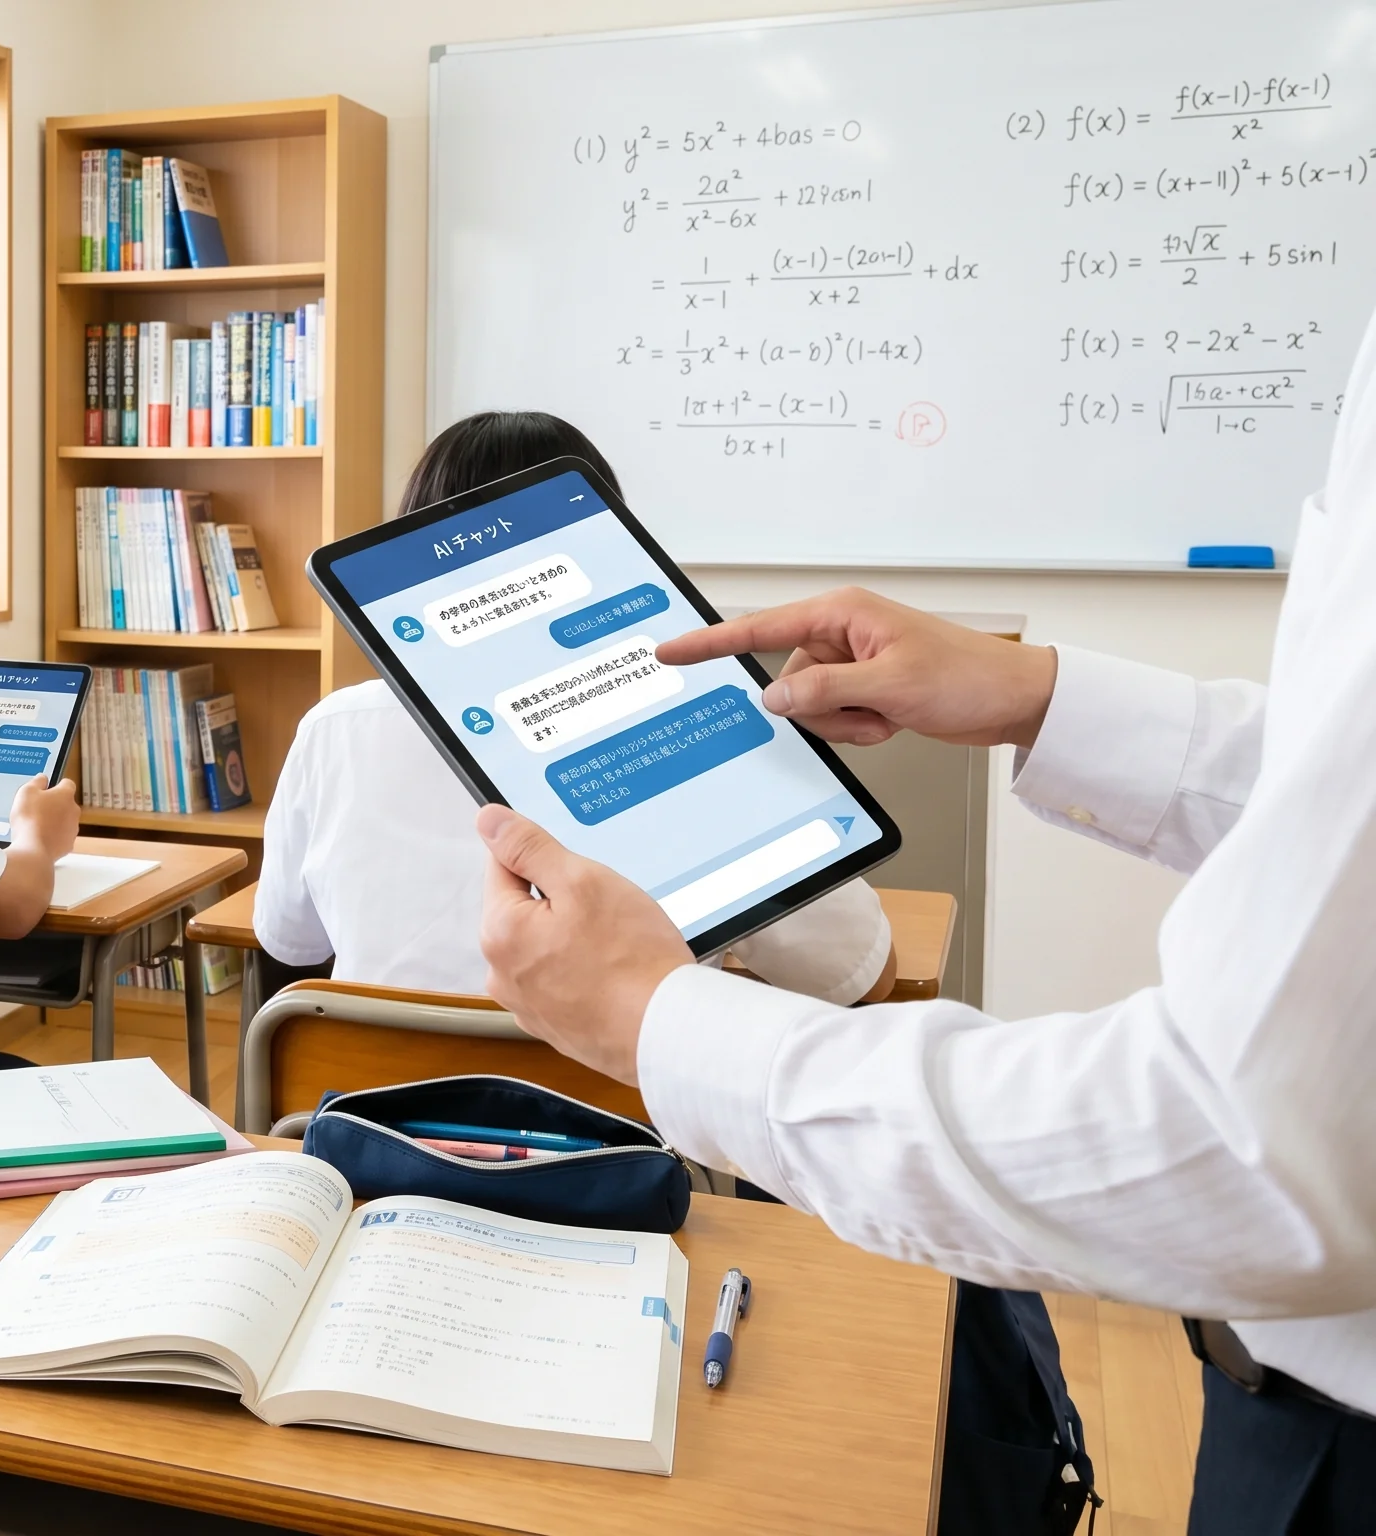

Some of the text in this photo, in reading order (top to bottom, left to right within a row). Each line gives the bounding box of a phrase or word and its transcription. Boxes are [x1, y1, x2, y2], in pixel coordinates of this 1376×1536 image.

[1006, 109, 1046, 141] (2)
[1066, 105, 1126, 141] f(x)
[574, 135, 606, 164] (1)
[1182, 268, 1198, 285] 2
